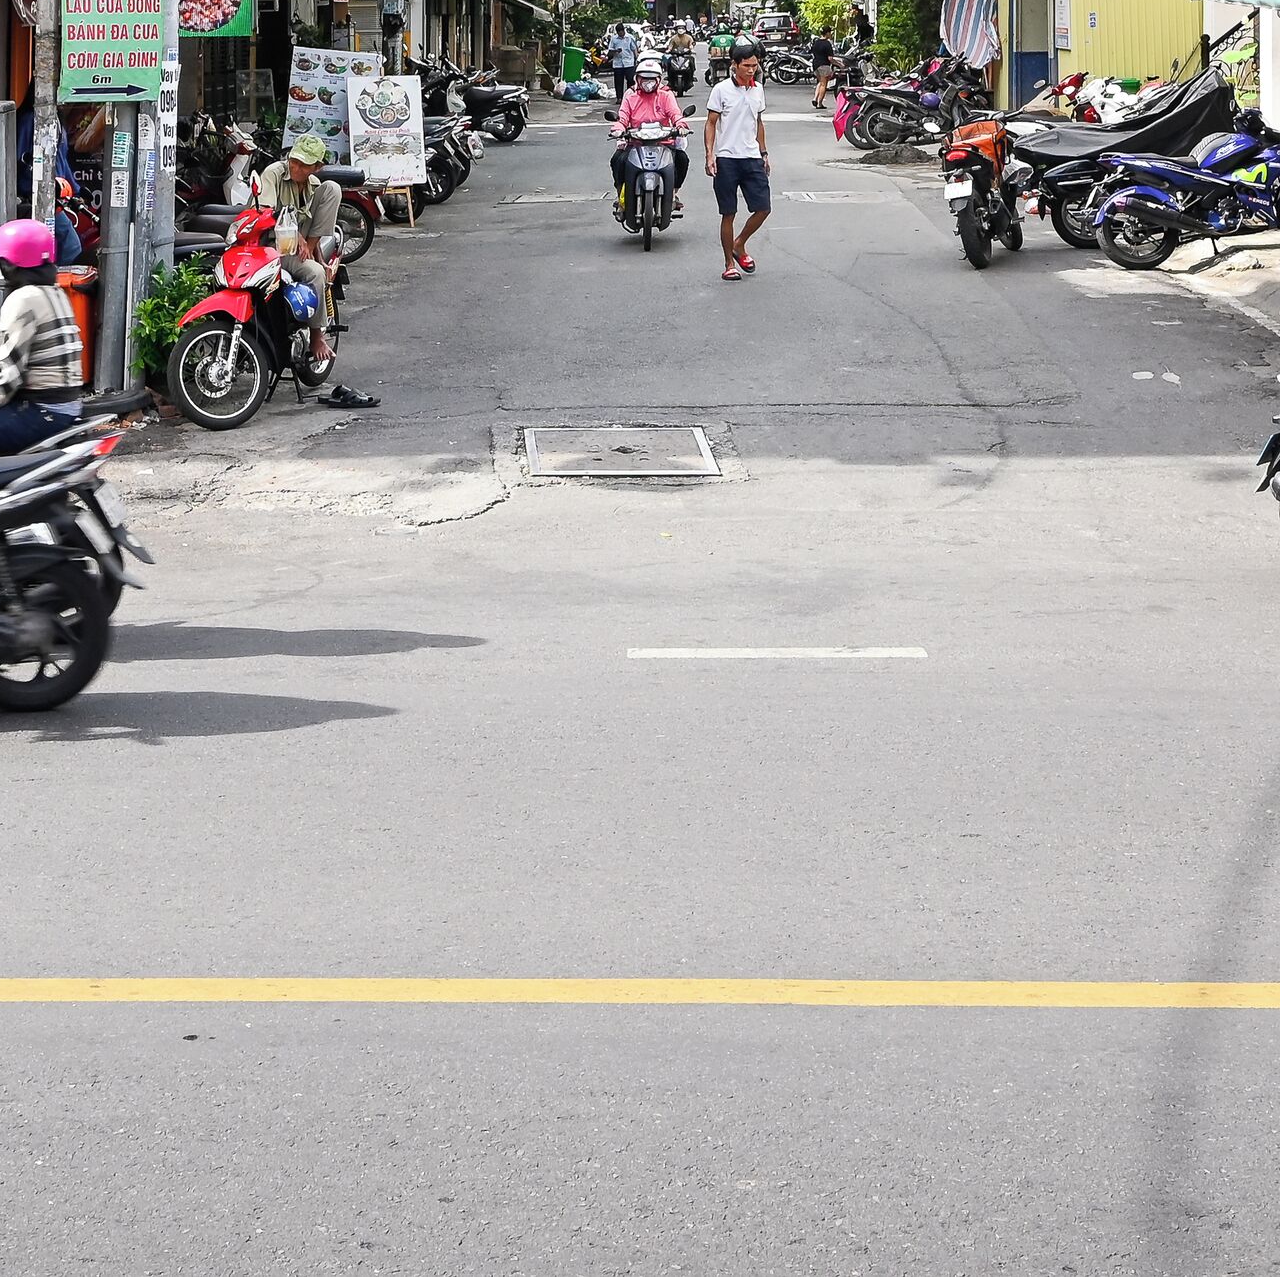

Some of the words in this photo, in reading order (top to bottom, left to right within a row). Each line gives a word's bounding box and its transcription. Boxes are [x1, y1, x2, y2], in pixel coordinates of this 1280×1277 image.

[66, 22, 106, 42] BÁNH
[110, 23, 129, 41] ĐA
[133, 22, 159, 41] CUA
[67, 51, 99, 70] CƠM
[102, 51, 124, 69] GIA
[127, 48, 159, 69] ĐÌNH
[91, 74, 112, 85] 6m
